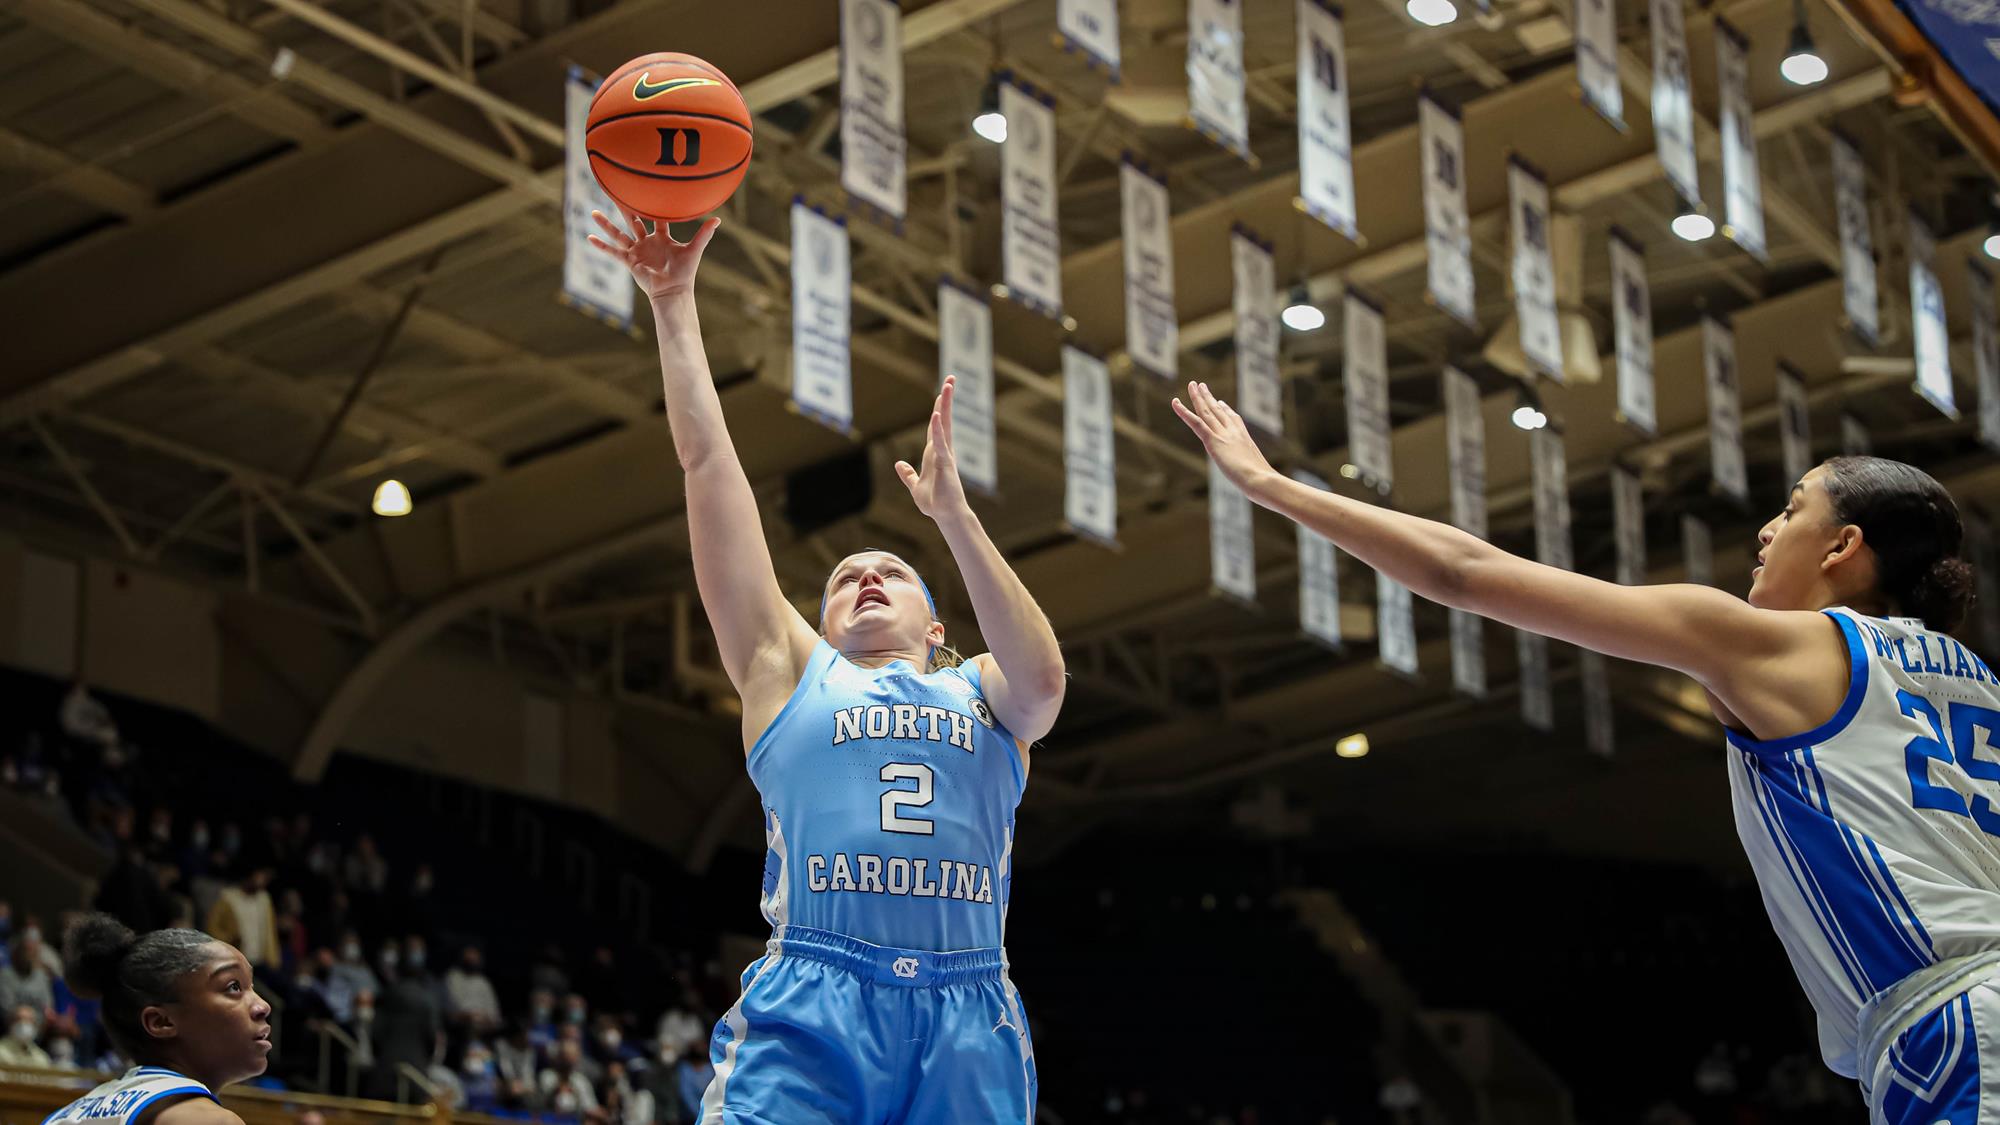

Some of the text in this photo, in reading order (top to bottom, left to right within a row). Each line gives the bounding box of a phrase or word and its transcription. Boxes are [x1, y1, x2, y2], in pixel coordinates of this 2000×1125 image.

[833, 704, 974, 754] NORTH
[1896, 688, 2000, 837] 25
[880, 762, 934, 835] 2
[807, 853, 993, 904] CAROLINA
